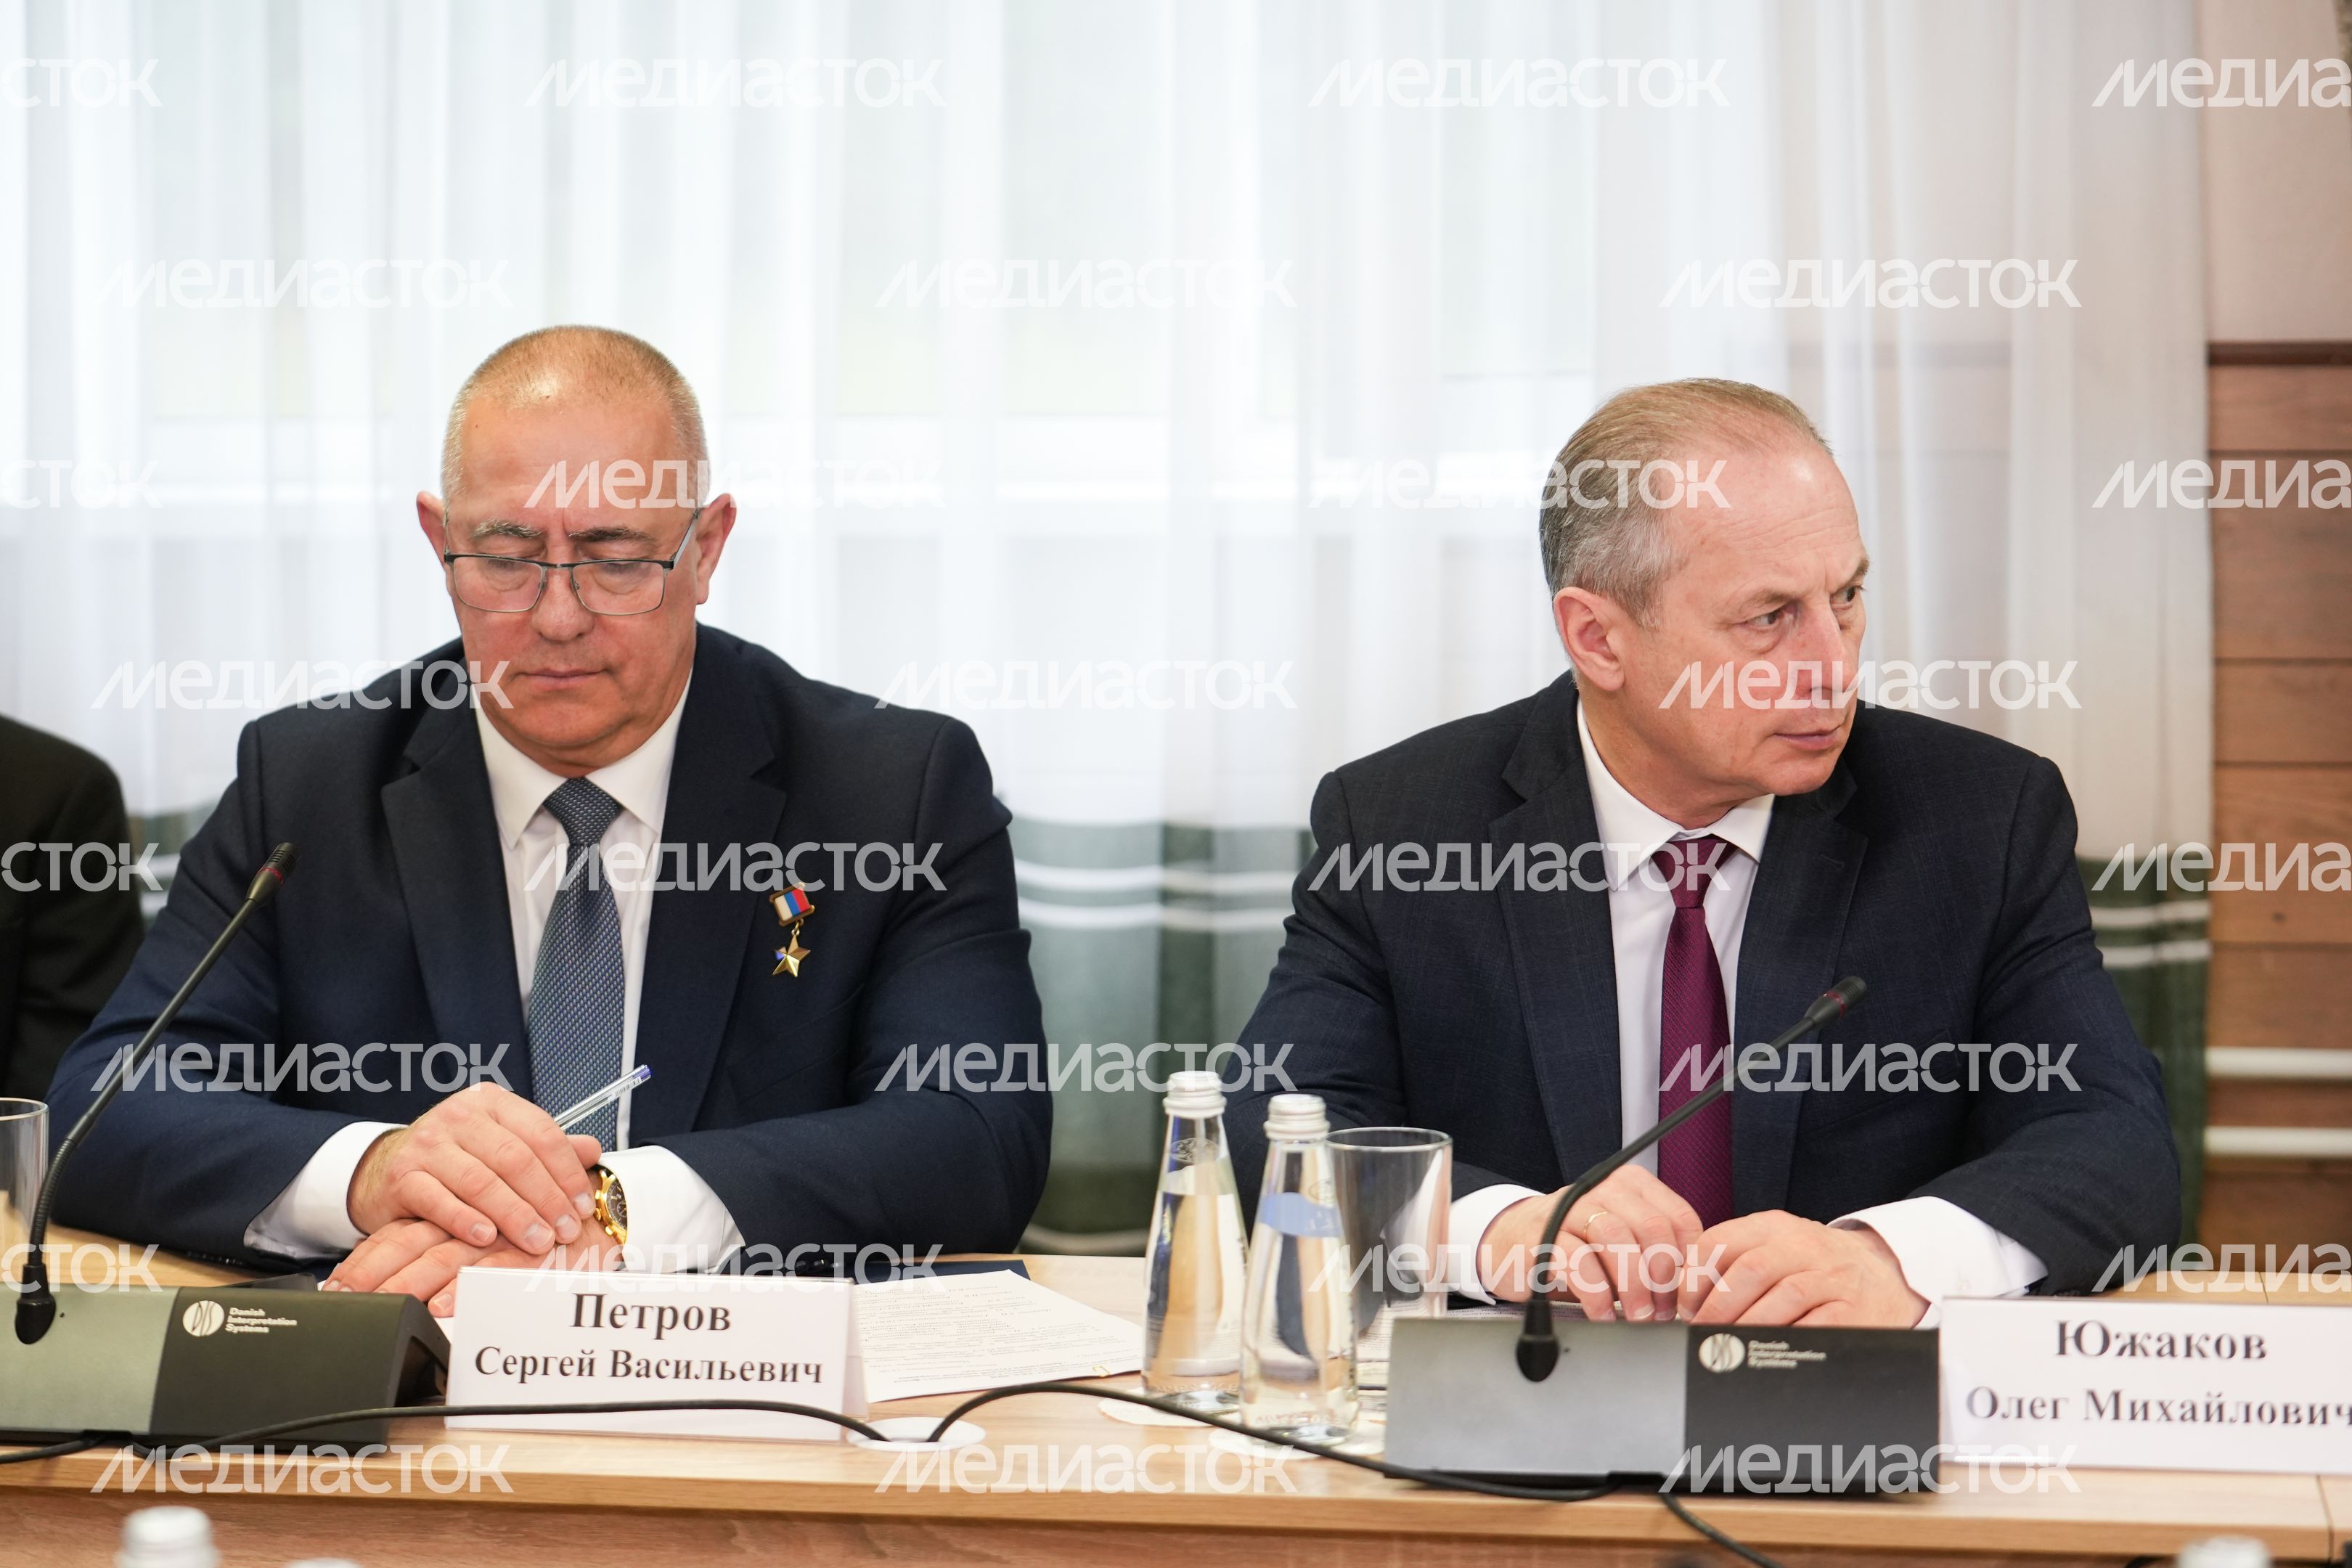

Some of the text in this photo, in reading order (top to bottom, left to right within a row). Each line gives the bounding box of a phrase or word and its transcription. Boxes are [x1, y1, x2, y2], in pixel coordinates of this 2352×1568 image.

[571, 1293, 731, 1341] Петров
[2055, 1320, 2267, 1360] Южаков
[474, 1345, 822, 1384] Сергей Васильевич
[1966, 1386, 2352, 1426] Олег Михайлович
